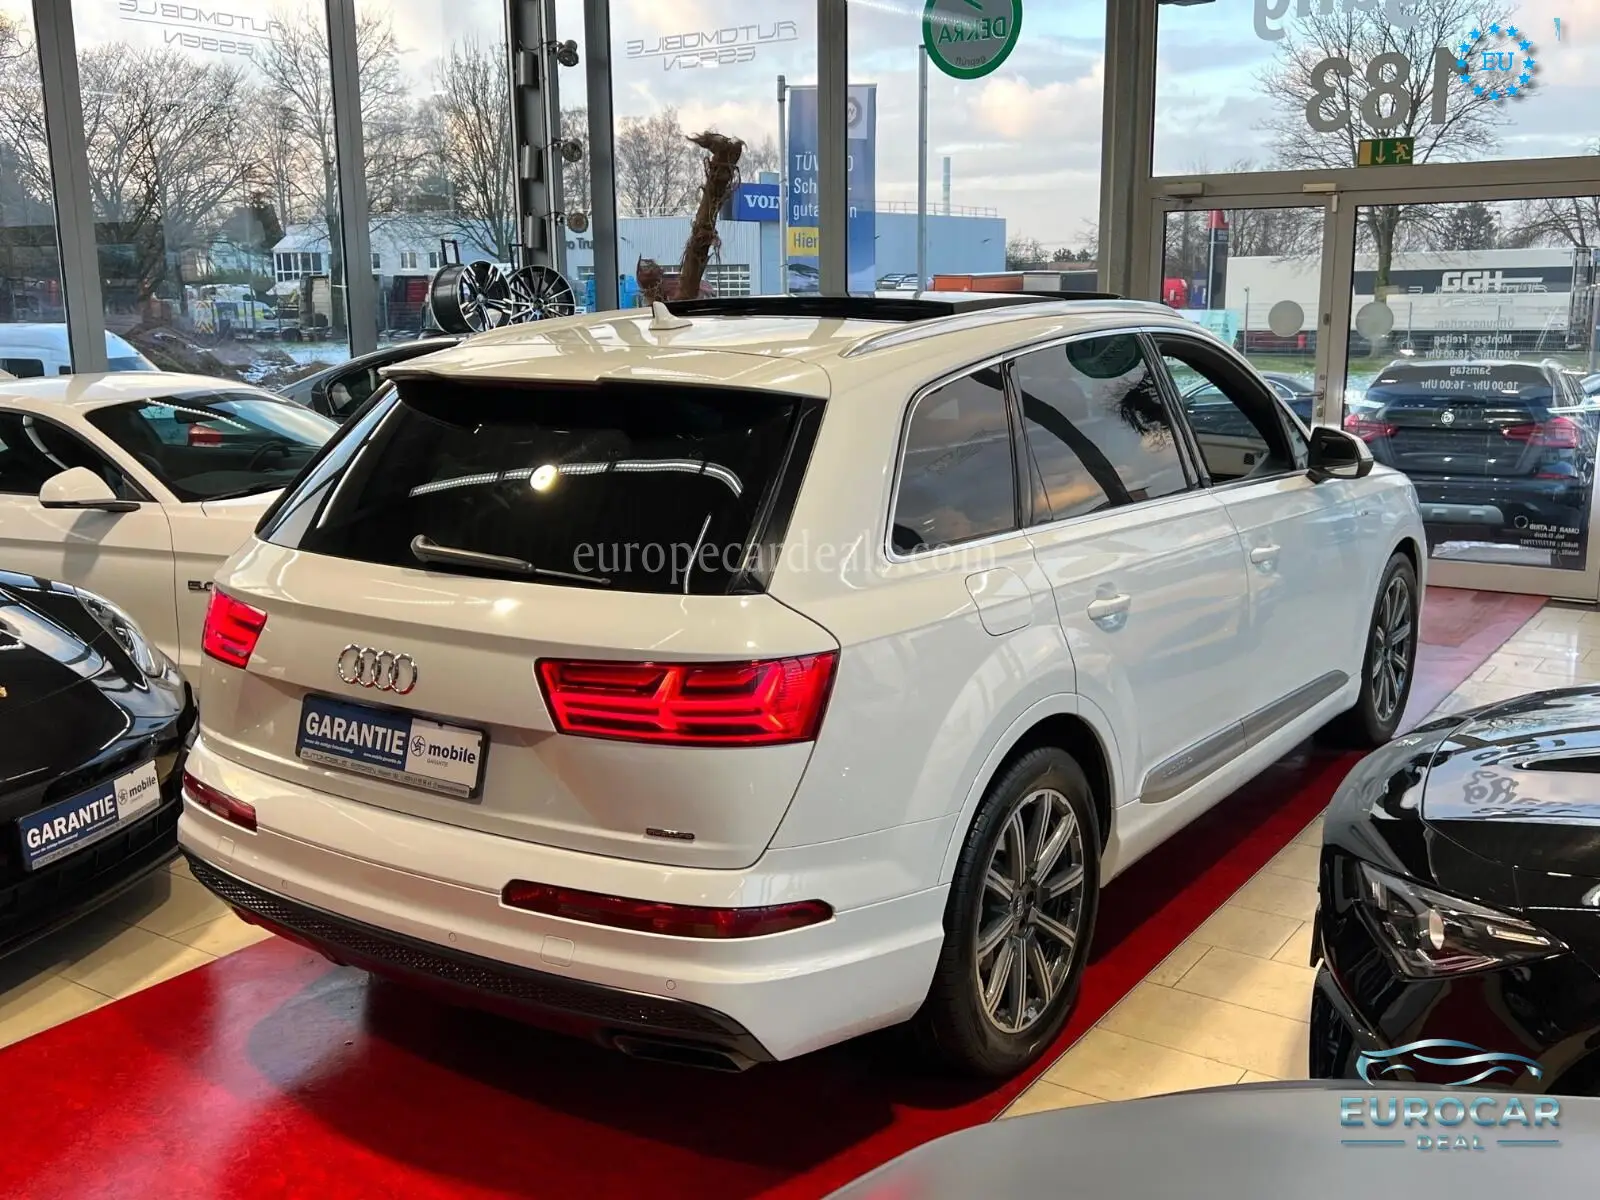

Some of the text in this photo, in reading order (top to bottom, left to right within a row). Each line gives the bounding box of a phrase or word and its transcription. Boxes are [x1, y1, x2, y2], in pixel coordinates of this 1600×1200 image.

[1442, 271, 1503, 291] GGH
[306, 711, 408, 755] GARANTIE
[428, 741, 476, 764] mobile
[129, 776, 156, 798] mobile
[26, 794, 116, 848] GARANTIE
